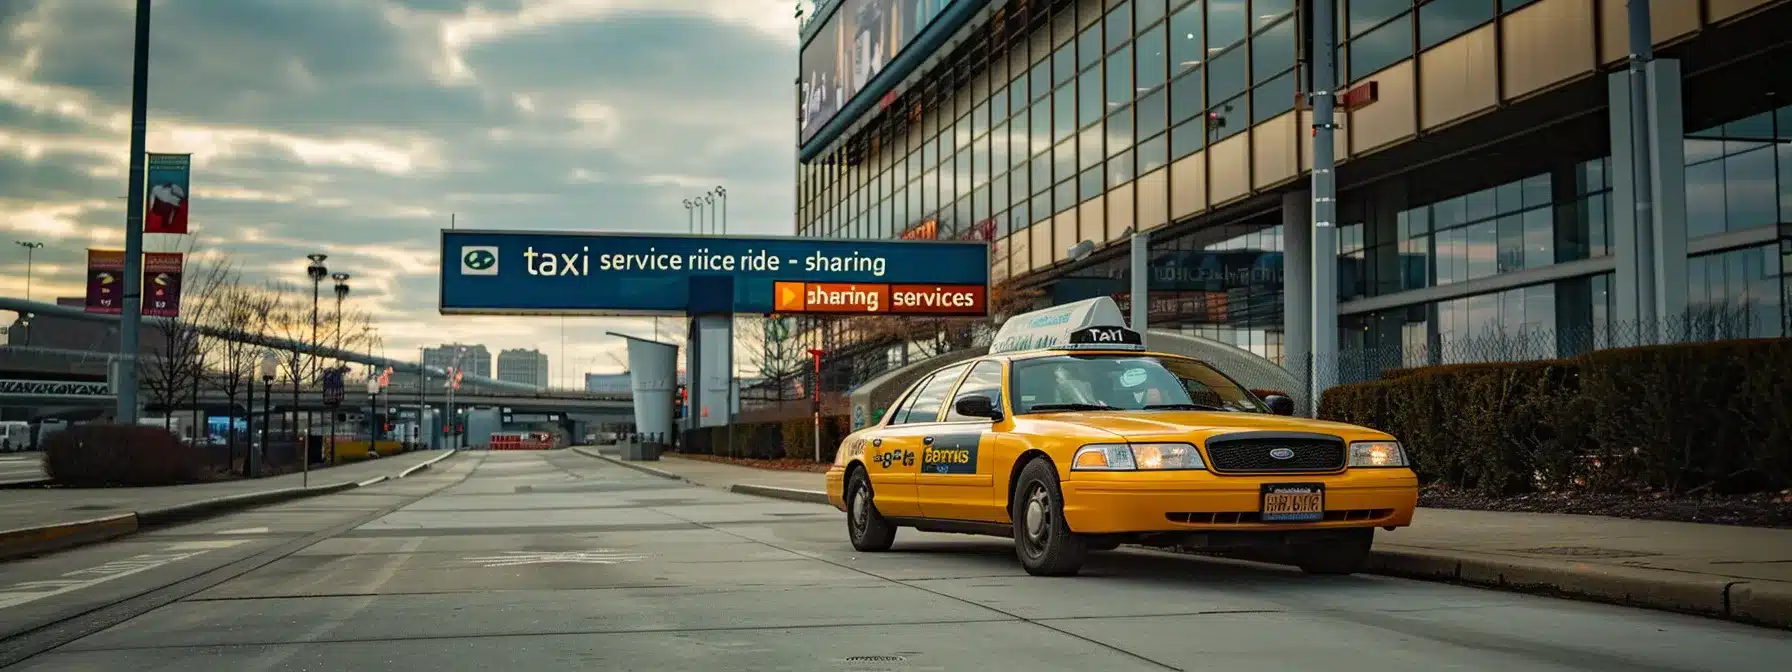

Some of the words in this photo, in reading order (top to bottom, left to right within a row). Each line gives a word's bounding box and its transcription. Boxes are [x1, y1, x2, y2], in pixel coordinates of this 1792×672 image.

[523, 245, 589, 276] taxi
[600, 247, 682, 271] service
[688, 248, 735, 271] riice
[741, 248, 780, 271] ride
[805, 250, 887, 277] sharing
[893, 287, 974, 307] services
